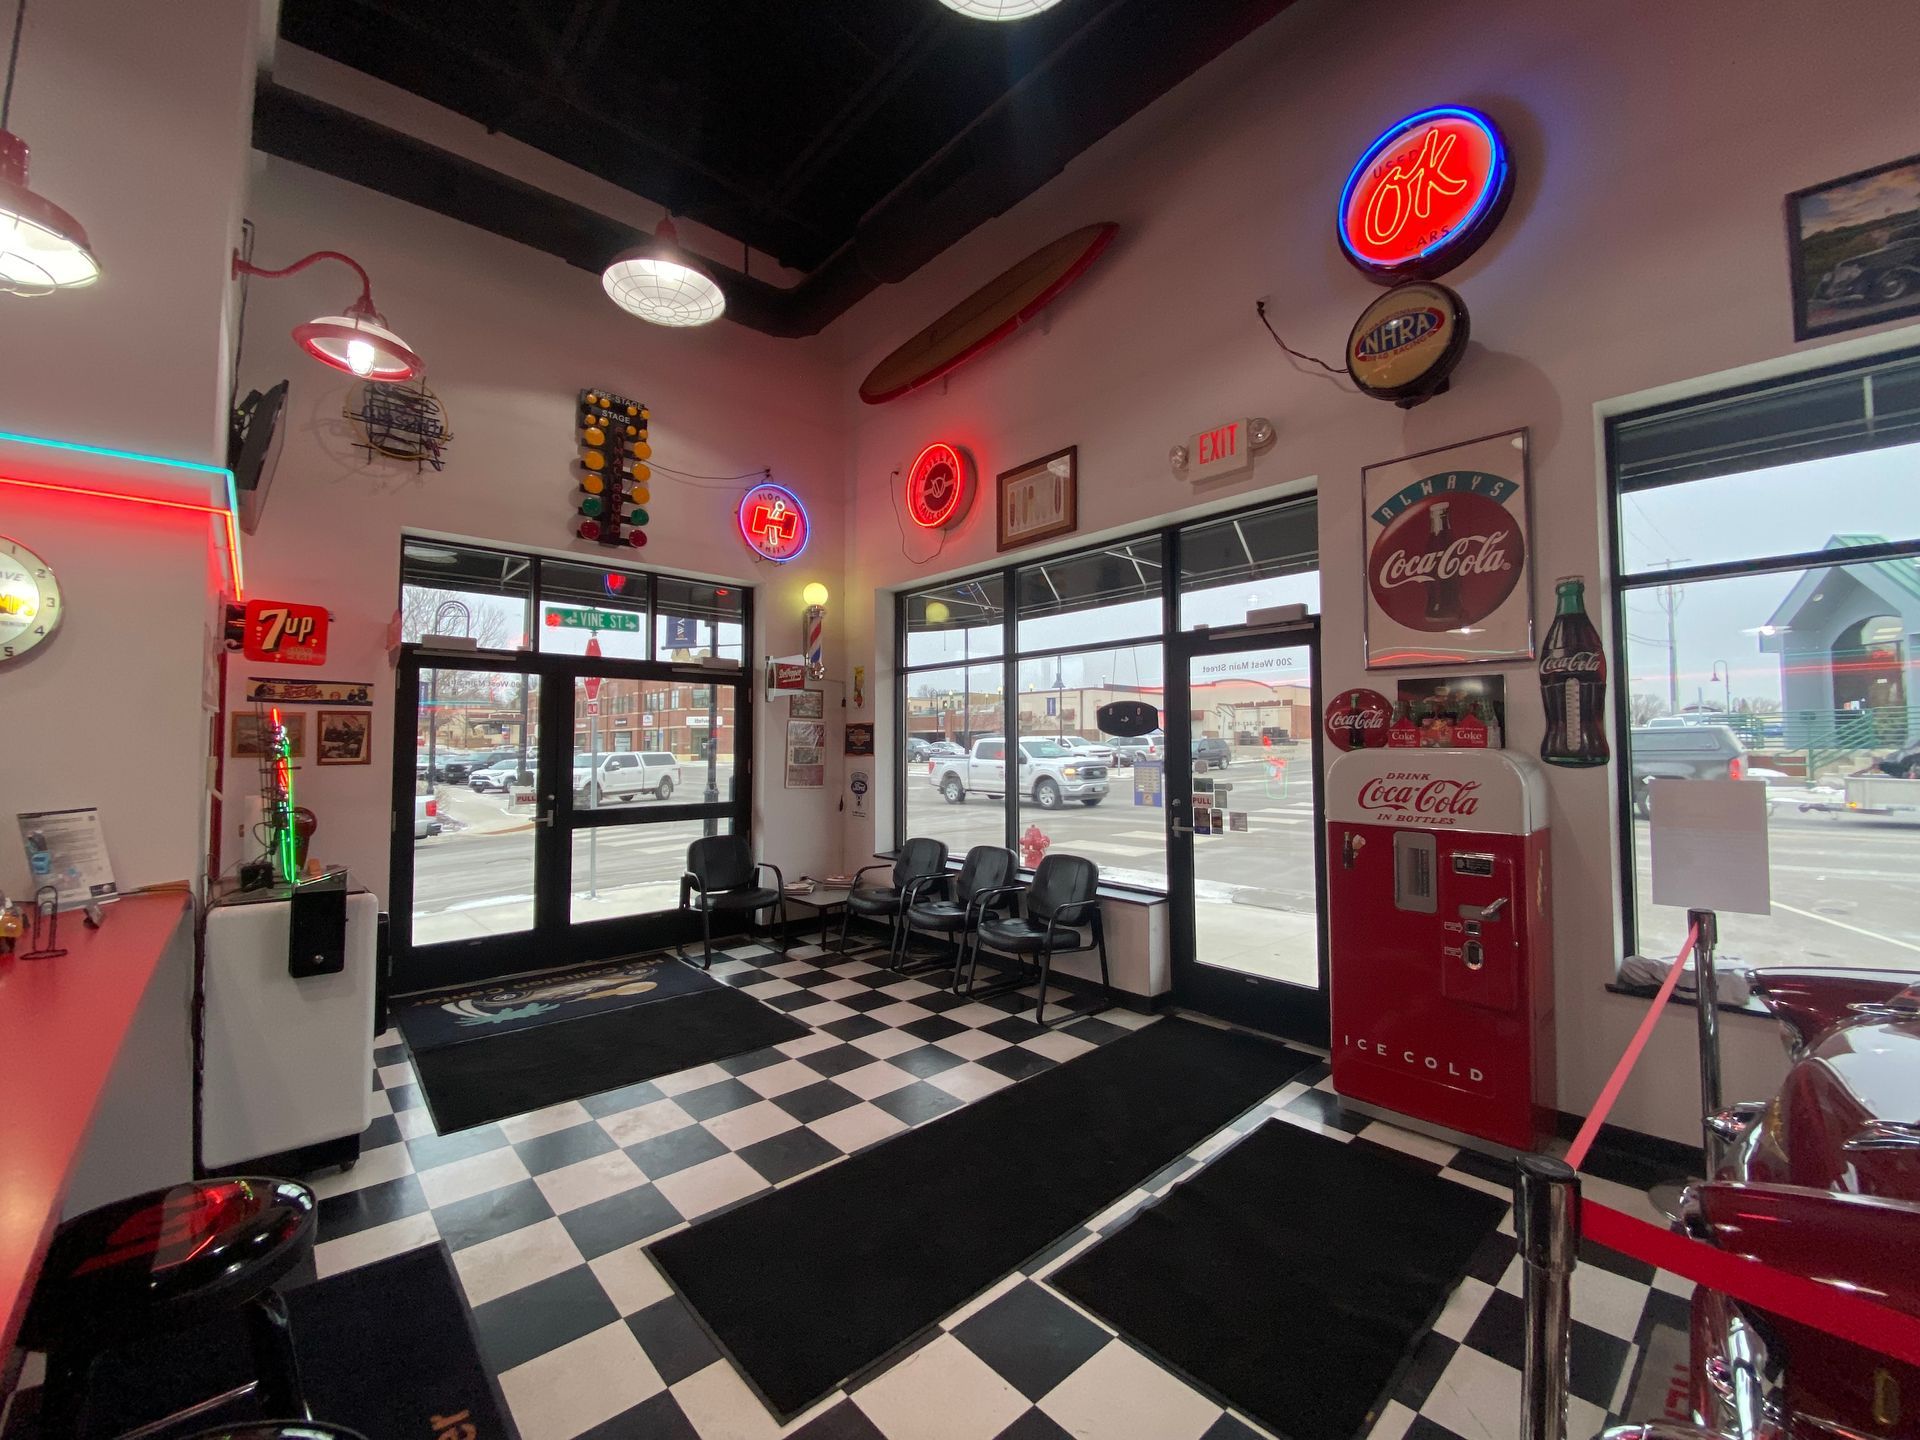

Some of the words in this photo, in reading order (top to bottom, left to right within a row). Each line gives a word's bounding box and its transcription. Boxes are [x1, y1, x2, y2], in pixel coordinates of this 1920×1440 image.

[1373, 149, 1420, 179] USED
[1365, 128, 1468, 245] OK
[1405, 226, 1451, 252] CARS
[1364, 312, 1431, 354] NHRA
[601, 409, 630, 424] STAGE
[1199, 422, 1239, 465] EXIT
[1380, 474, 1506, 520] ALWAYS
[36, 568, 46, 578] 2
[46, 597, 56, 608] 3
[580, 612, 605, 628] VINE
[610, 615, 624, 629] ST
[34, 626, 45, 637] 4
[4, 646, 14, 657] 5
[1391, 731, 1416, 742] Coke
[1456, 730, 1483, 741] Coke
[1386, 772, 1432, 781] DRINK
[1192, 796, 1212, 805] PULL
[1358, 777, 1483, 816] Coca-Cola
[1376, 813, 1392, 821] IN
[1396, 814, 1457, 825] BOTTLES
[1344, 1034, 1387, 1056] ICE
[1404, 1051, 1485, 1082] COLD
